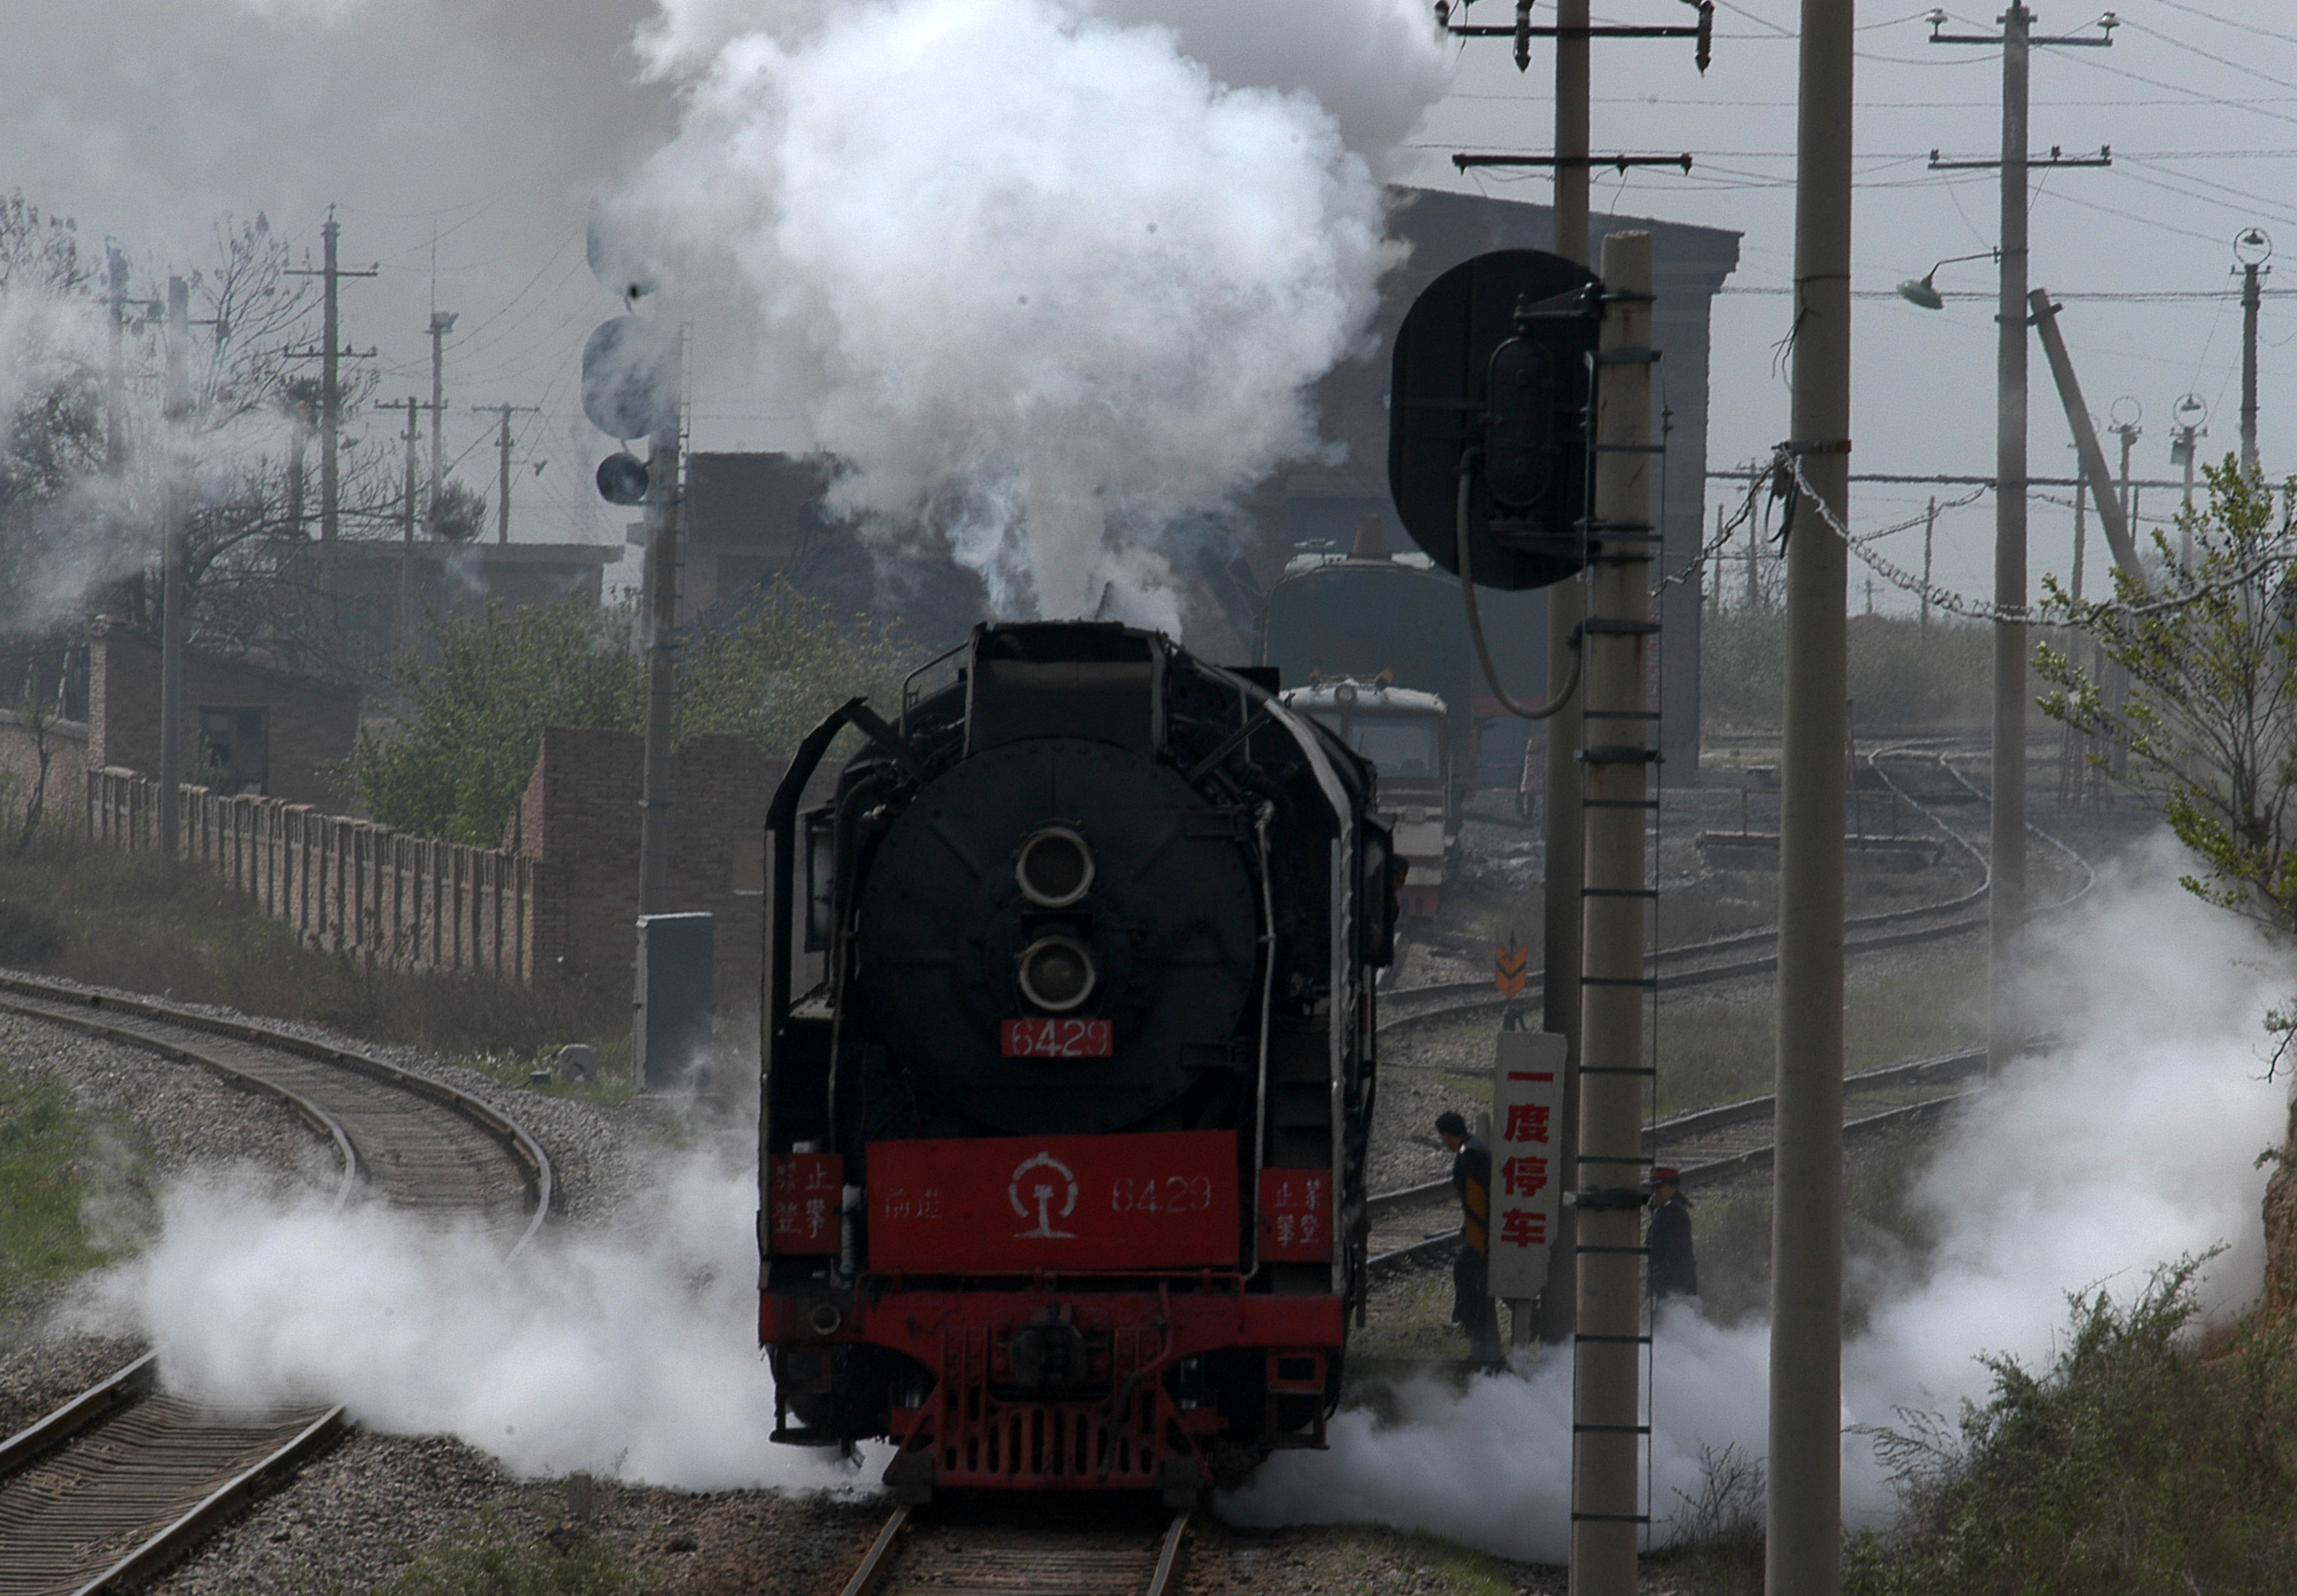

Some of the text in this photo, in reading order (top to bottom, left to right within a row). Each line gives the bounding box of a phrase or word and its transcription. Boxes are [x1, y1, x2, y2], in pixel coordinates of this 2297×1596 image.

[1011, 1018, 1108, 1057] 6429
[1501, 1070, 1554, 1248] 一度停车
[1111, 1174, 1212, 1215] 6429
